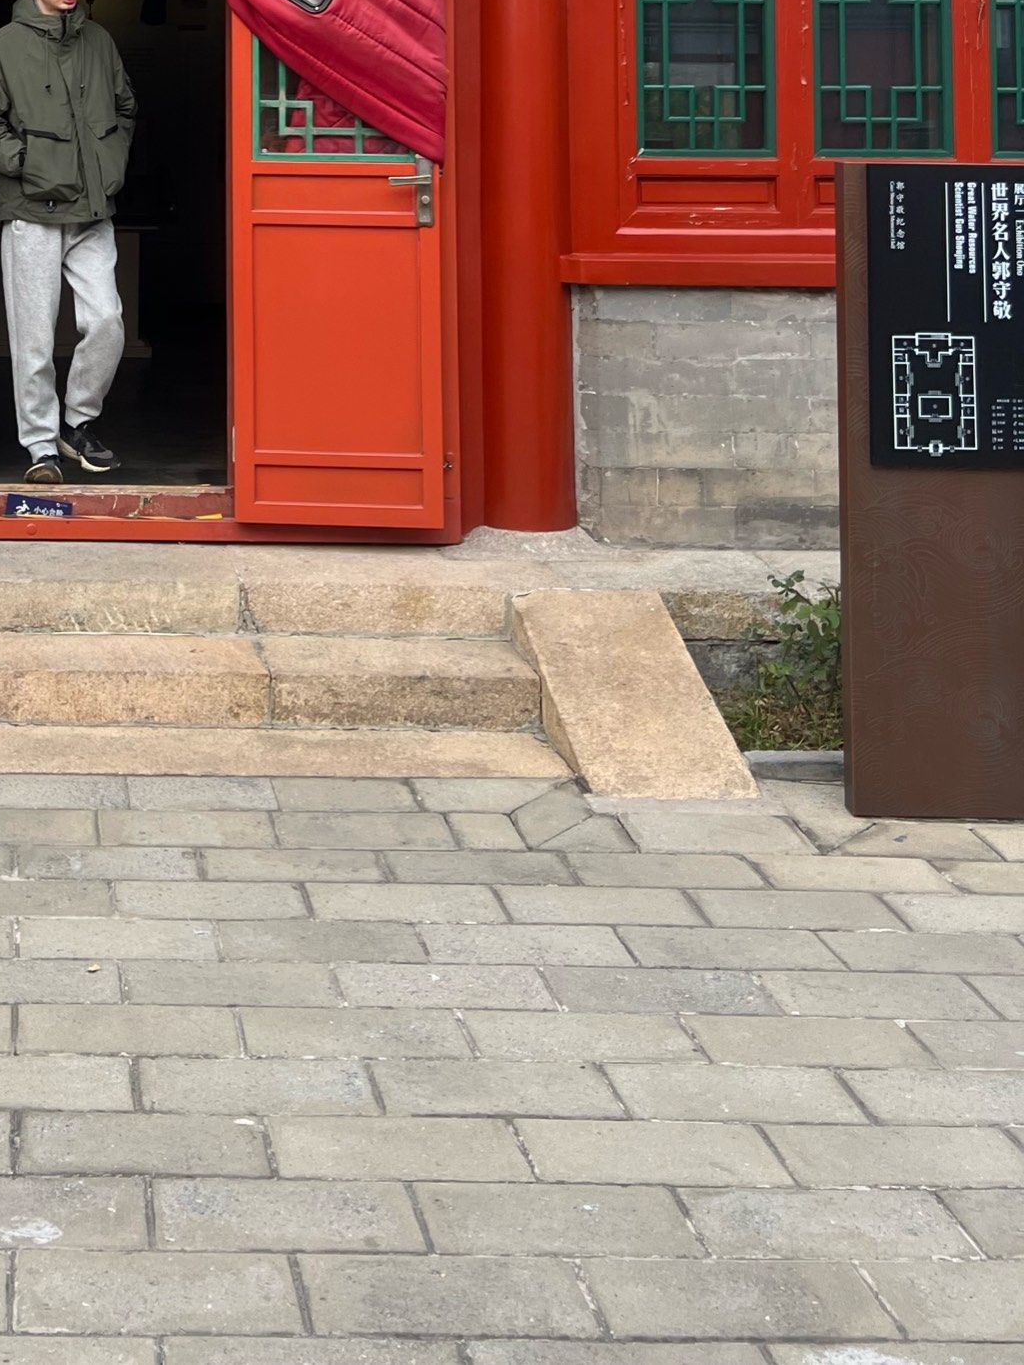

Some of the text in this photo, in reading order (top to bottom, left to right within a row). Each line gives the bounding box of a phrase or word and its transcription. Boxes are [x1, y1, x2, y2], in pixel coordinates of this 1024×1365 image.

[954, 182, 965, 269] Scientist Guo Shoujing
[967, 182, 977, 274] Great Water Resources
[991, 182, 1012, 320] 世界名人郭守敬
[1015, 219, 1024, 259] Exhibition
